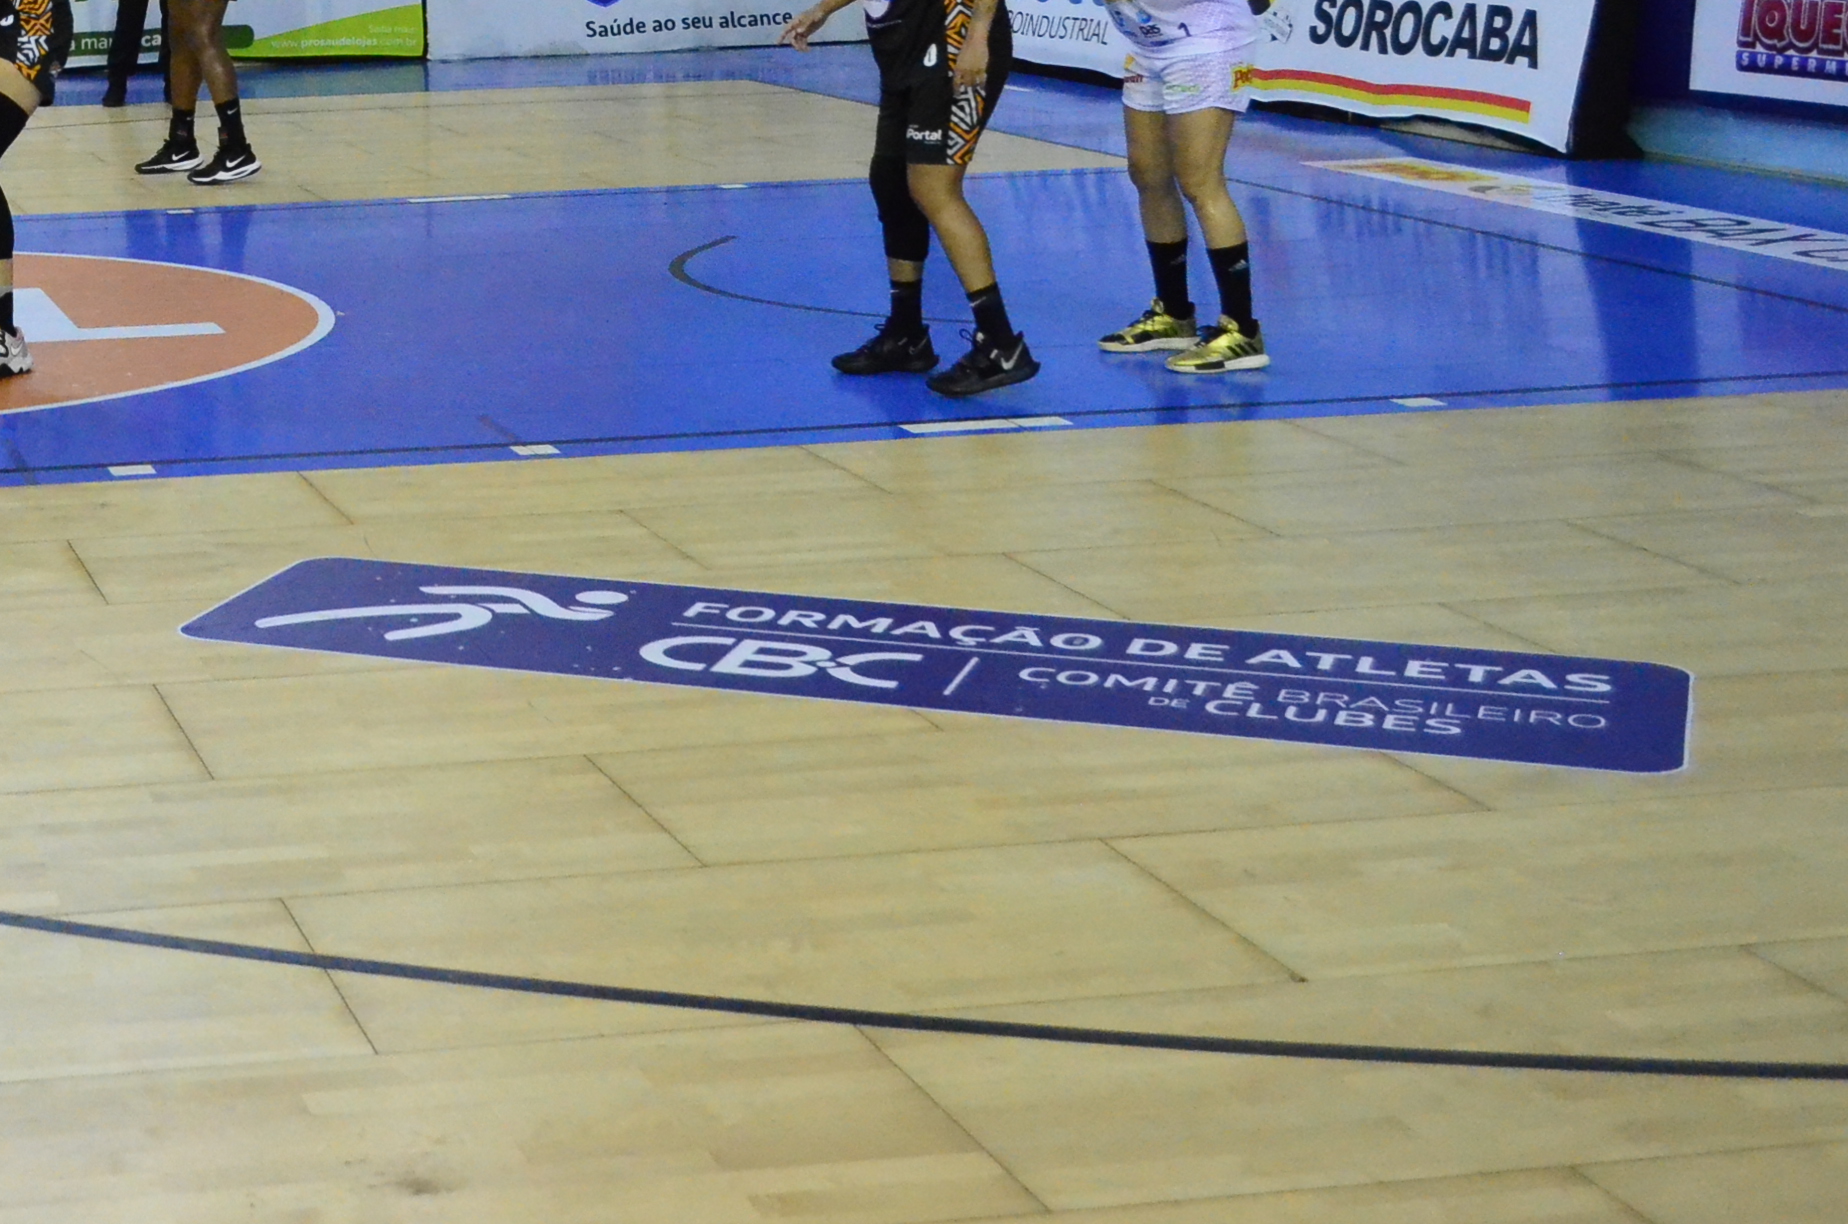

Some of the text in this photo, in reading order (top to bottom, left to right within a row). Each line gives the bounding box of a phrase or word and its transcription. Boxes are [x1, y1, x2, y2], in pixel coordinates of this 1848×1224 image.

[585, 10, 793, 39] Saúde ao seu alcance
[906, 128, 942, 141] Portal
[639, 635, 924, 689] CBC
[681, 601, 1614, 694] FORMAÇÃO DE ATLETAS
[1016, 665, 1609, 730] COMITÊ BRASILEIRO
[1148, 696, 1464, 736] DE CLUBES
